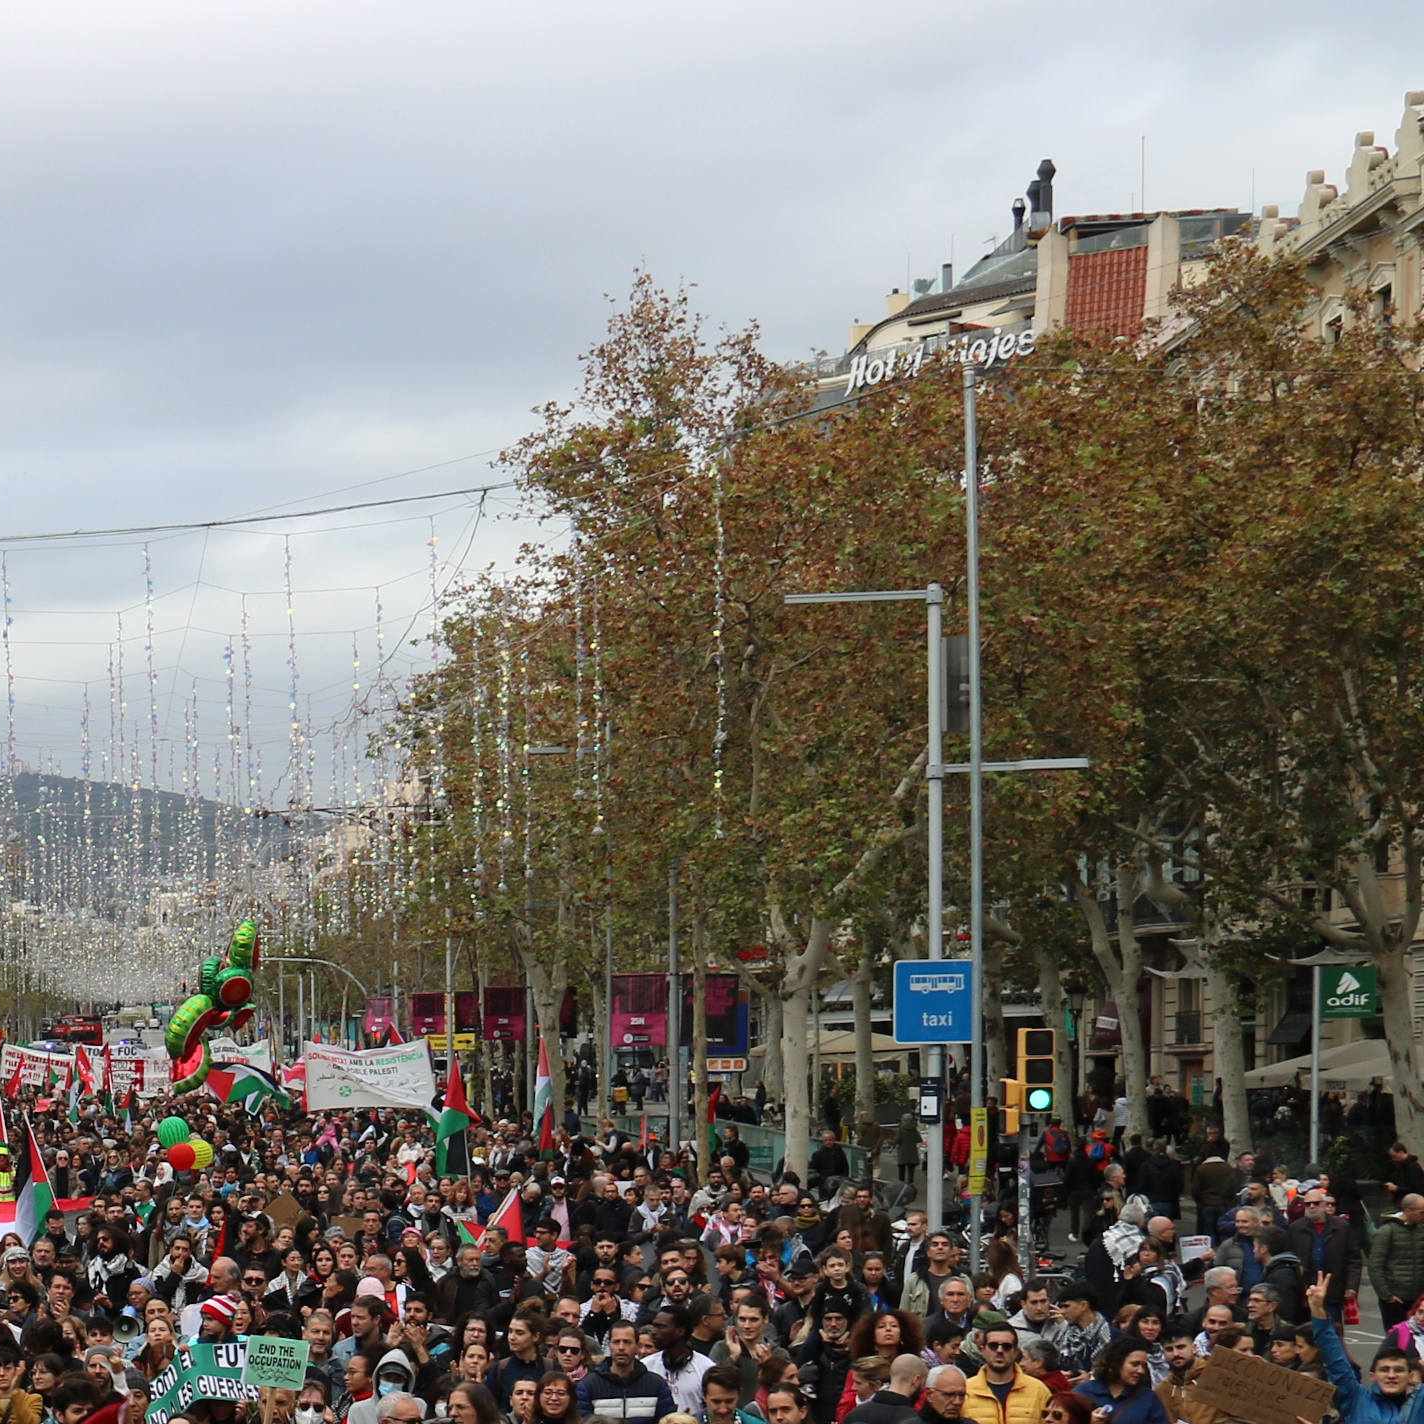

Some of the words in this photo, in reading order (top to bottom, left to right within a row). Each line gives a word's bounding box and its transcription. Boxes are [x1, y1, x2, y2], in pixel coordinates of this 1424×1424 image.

[1326, 993, 1370, 1006] adif
[921, 1011, 953, 1026] taxi
[257, 1343, 277, 1355] END
[278, 1345, 295, 1358] THE
[248, 1354, 302, 1370] OCCUPATION
[149, 1364, 178, 1400] SOM
[213, 1343, 248, 1368] FUT
[177, 1381, 193, 1409] LES
[196, 1375, 260, 1401] GUERRES
